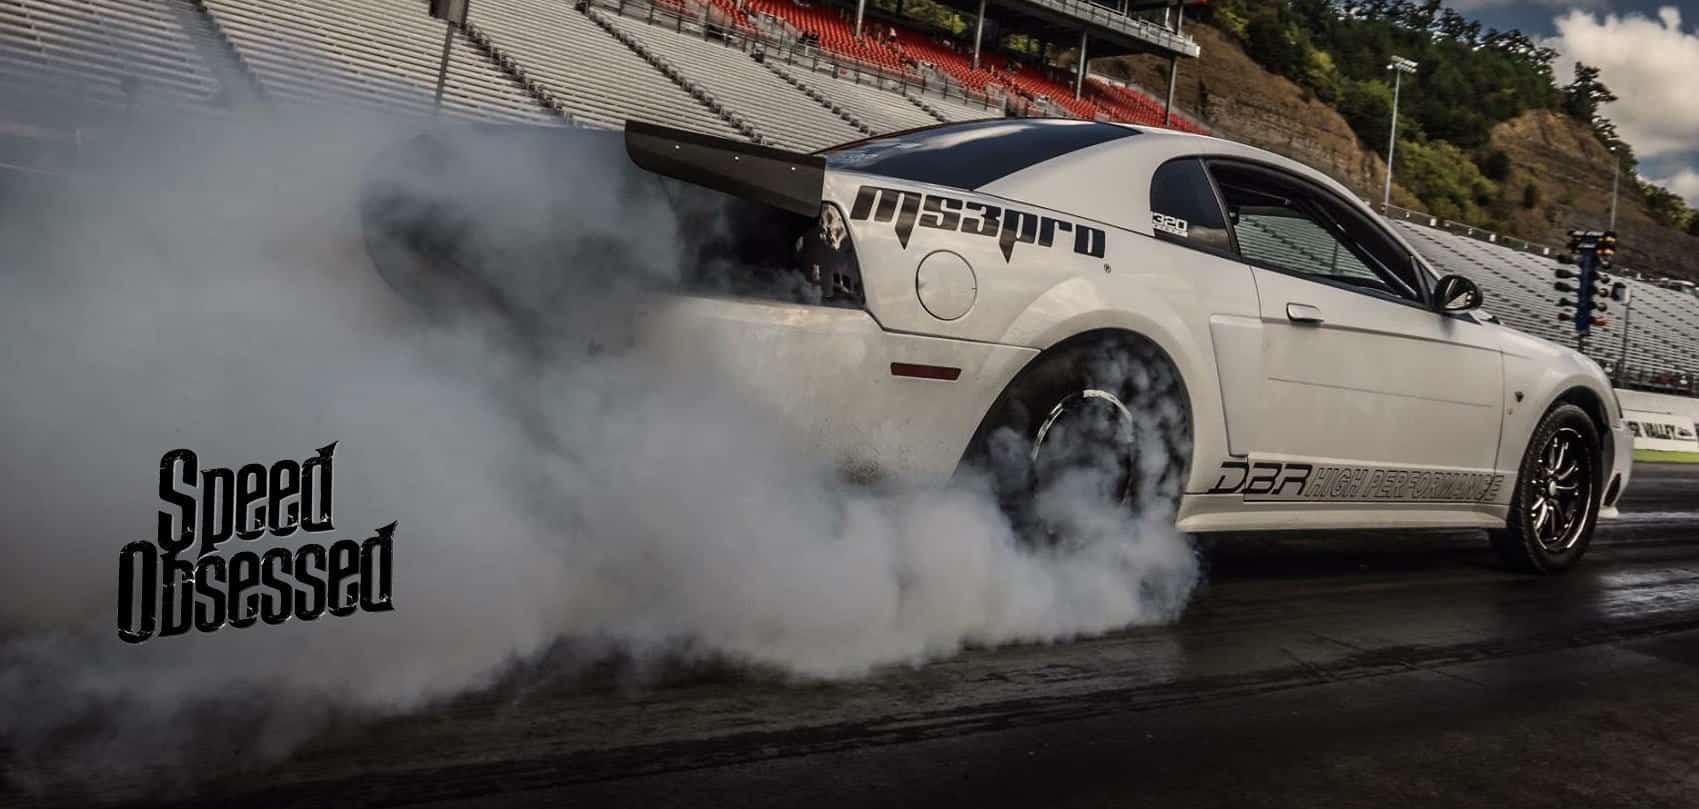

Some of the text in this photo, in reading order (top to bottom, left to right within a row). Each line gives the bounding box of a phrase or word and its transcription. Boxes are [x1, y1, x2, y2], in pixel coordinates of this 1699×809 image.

[1152, 212, 1188, 233] 320
[1208, 461, 1504, 501] DBR HIGH PERFORMANCE
